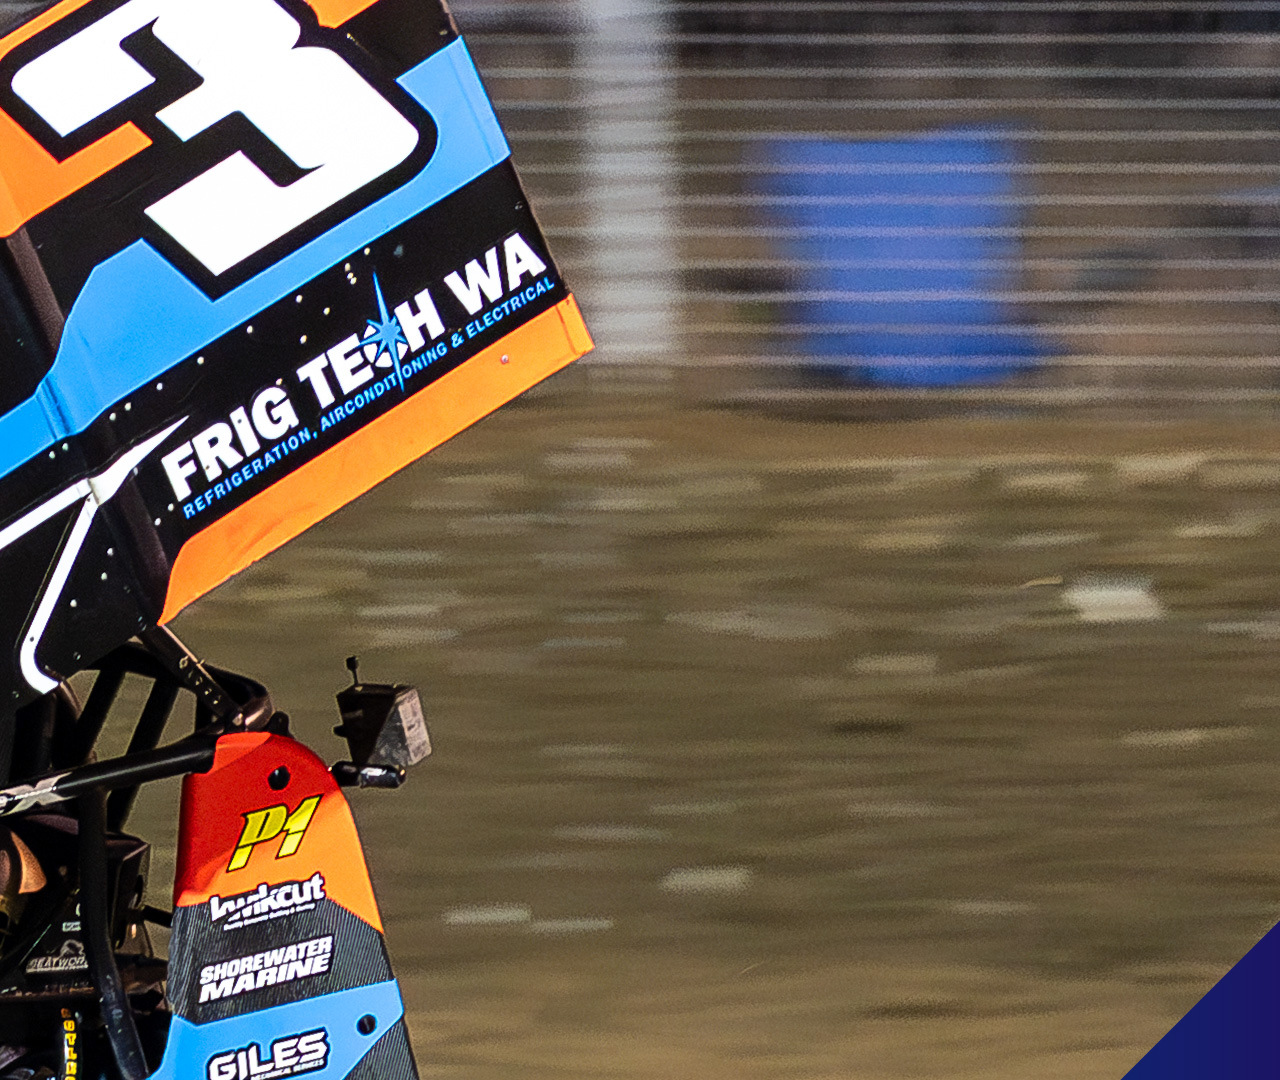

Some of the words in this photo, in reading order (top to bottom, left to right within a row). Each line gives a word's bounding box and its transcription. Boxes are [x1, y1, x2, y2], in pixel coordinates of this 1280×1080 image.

[11, 0, 420, 276] 3
[161, 386, 300, 502] FRIG
[444, 232, 546, 316] WA
[320, 342, 447, 432] AIRCONDITONING
[451, 329, 465, 349] &
[466, 276, 555, 339] ELECTRICAL
[226, 793, 324, 873] P1
[198, 952, 331, 1004] MARINE
[199, 935, 333, 985] SHOREWATER
